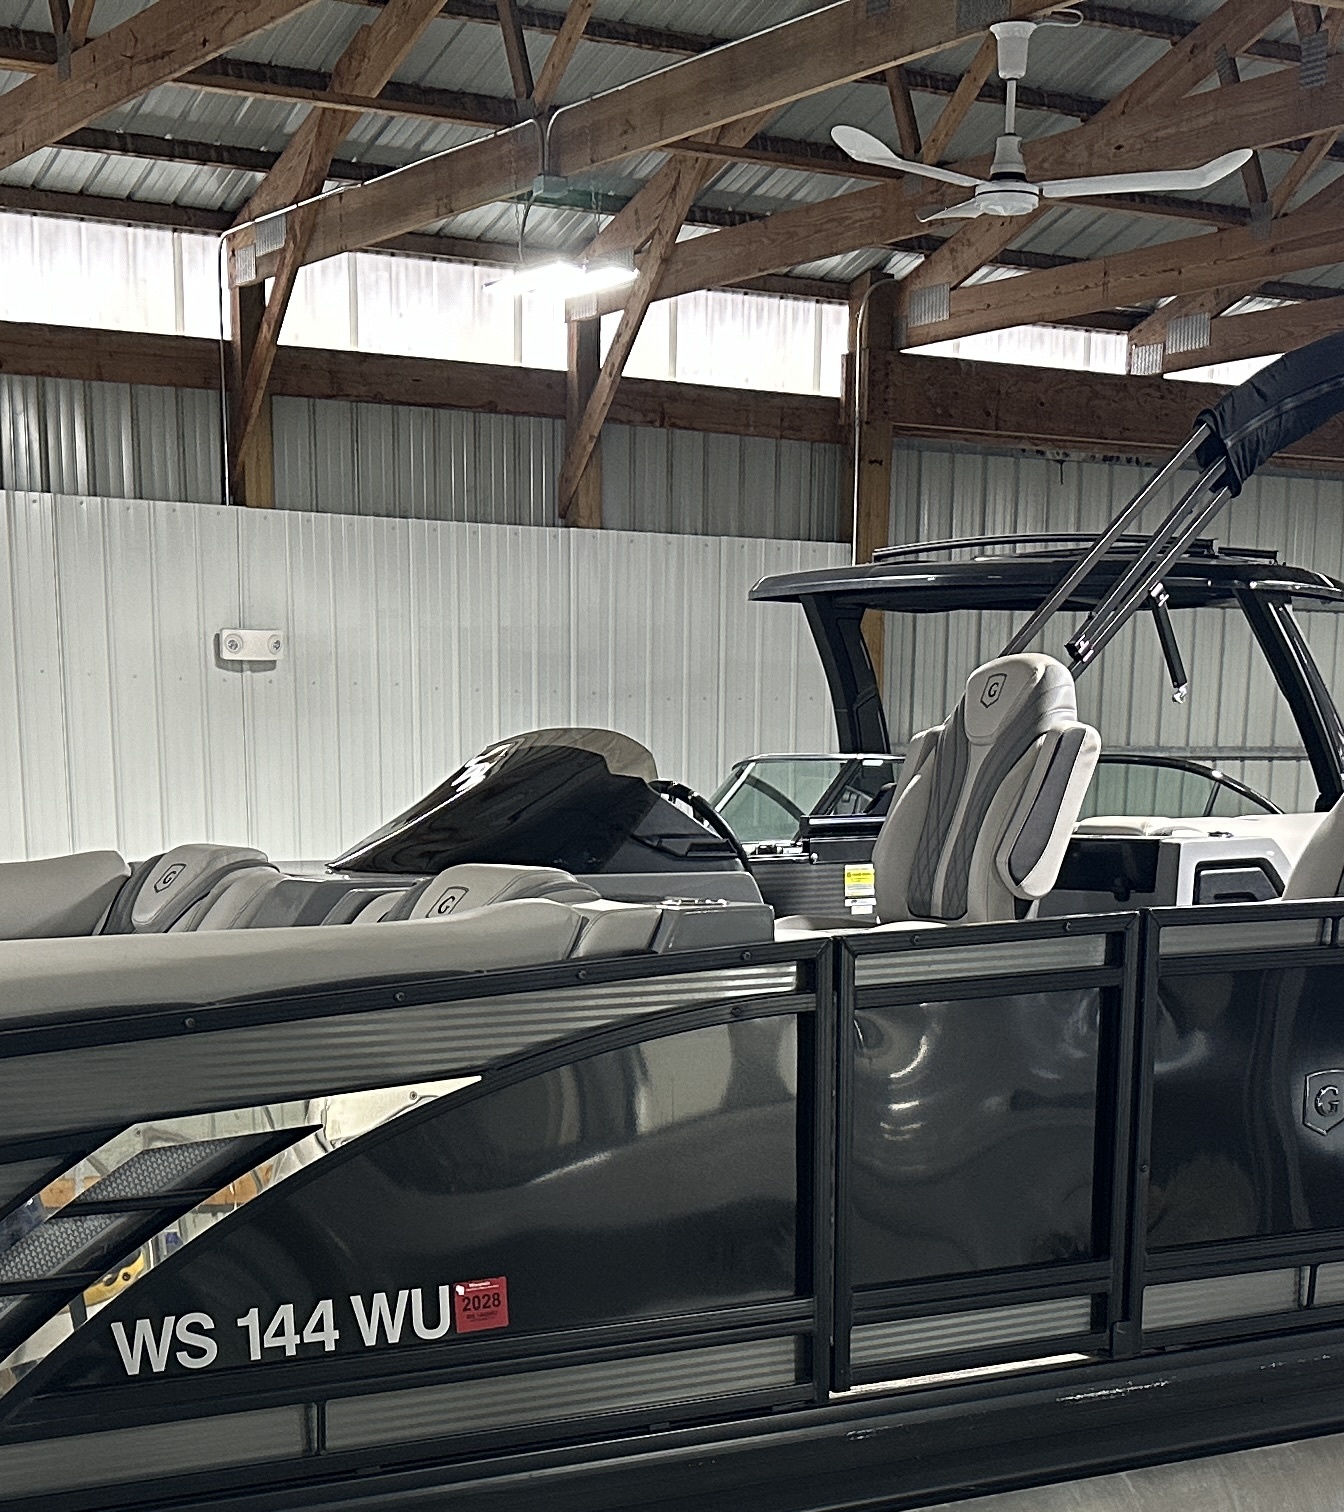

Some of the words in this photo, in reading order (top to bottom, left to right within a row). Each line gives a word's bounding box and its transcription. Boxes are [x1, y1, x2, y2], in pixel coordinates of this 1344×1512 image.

[462, 1292, 502, 1312] 2028
[110, 1312, 218, 1376] WS
[237, 1299, 340, 1361] 144
[350, 1285, 451, 1347] WU
